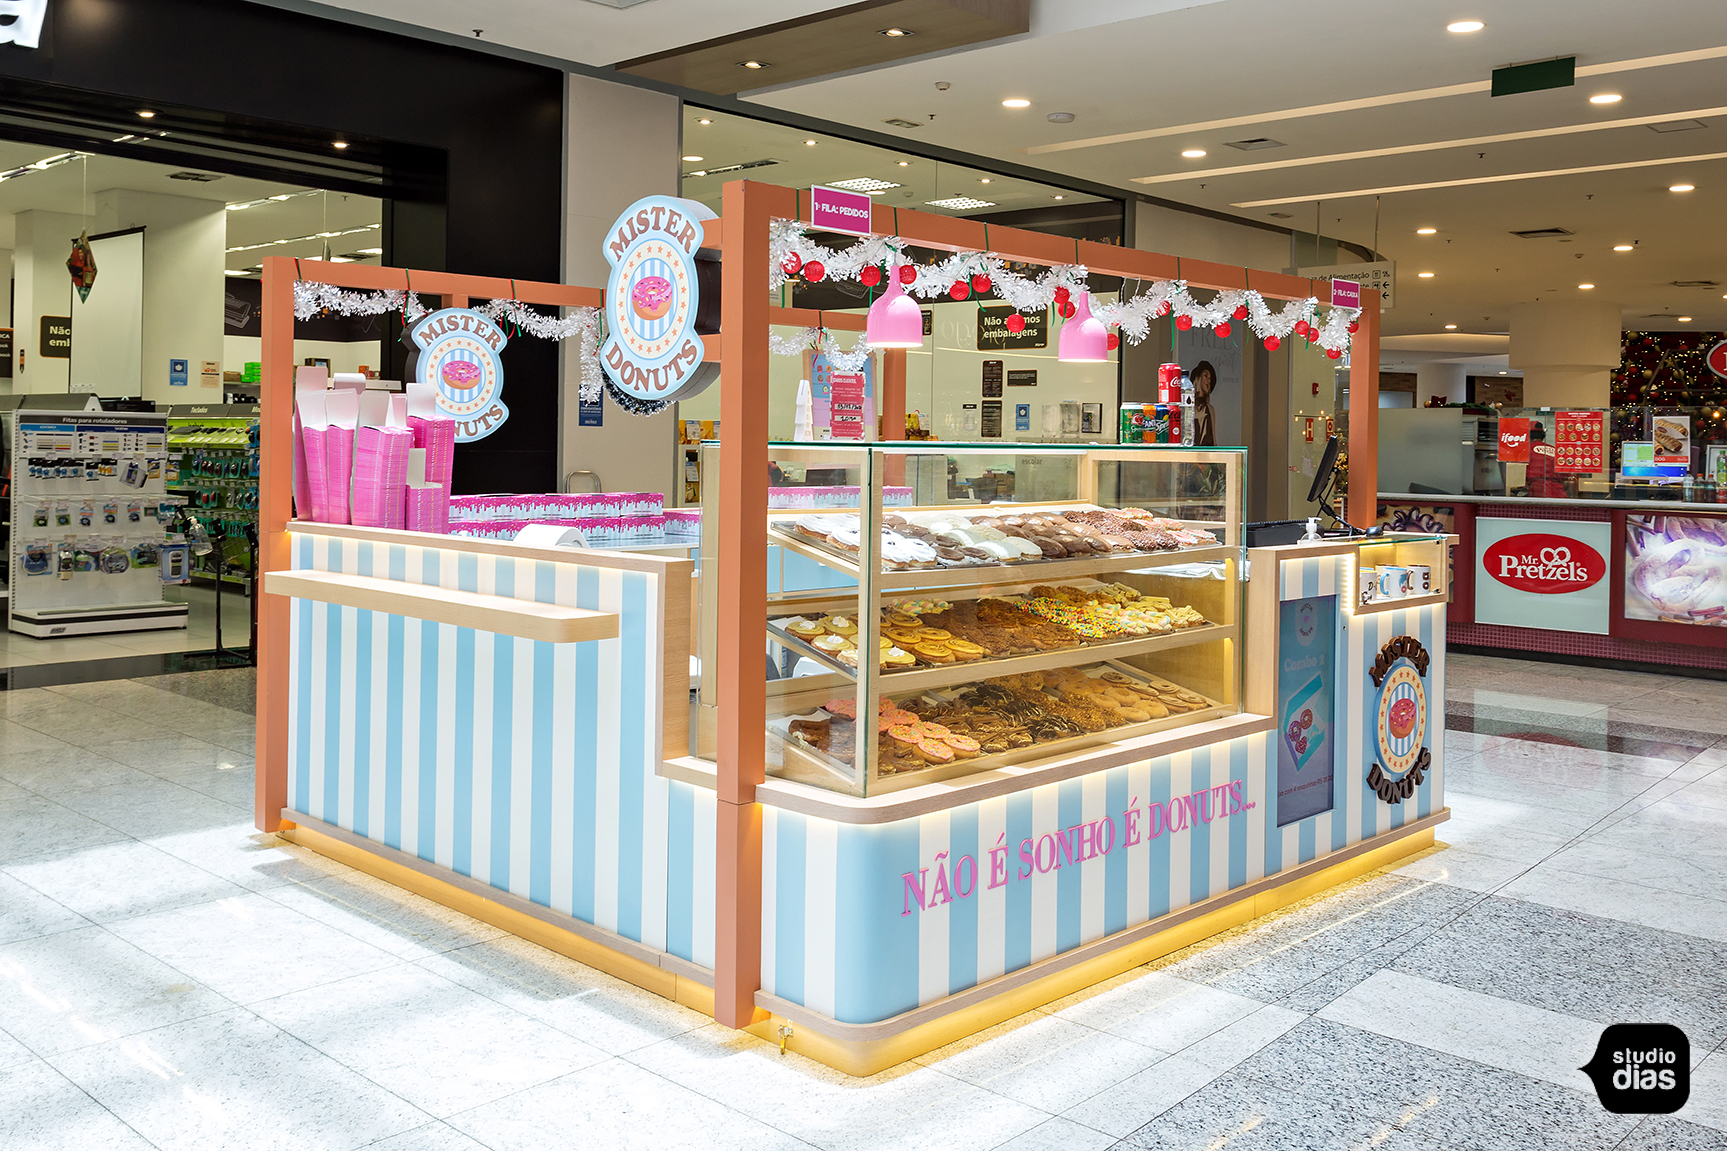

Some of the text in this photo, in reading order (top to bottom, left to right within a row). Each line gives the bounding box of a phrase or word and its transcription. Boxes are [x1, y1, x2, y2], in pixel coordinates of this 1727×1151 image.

[821, 203, 838, 214] FILA:
[839, 206, 869, 219] PEDIDOS
[609, 206, 696, 262] MISTER
[418, 314, 501, 351] MISTER
[984, 316, 1002, 326] Não
[605, 341, 698, 392] DONUTS
[1501, 433, 1527, 443] ifood
[1021, 457, 1043, 466] escolar
[1498, 554, 1588, 582] Pretzels
[1521, 554, 1539, 565] Mr.
[1284, 654, 1317, 673] Combo
[1368, 635, 1431, 688] MISTER
[1366, 746, 1432, 805] DONUTS
[901, 849, 979, 918] NÃO
[987, 830, 1010, 890] É
[1017, 815, 1116, 882] SONHO
[1122, 795, 1142, 849] É
